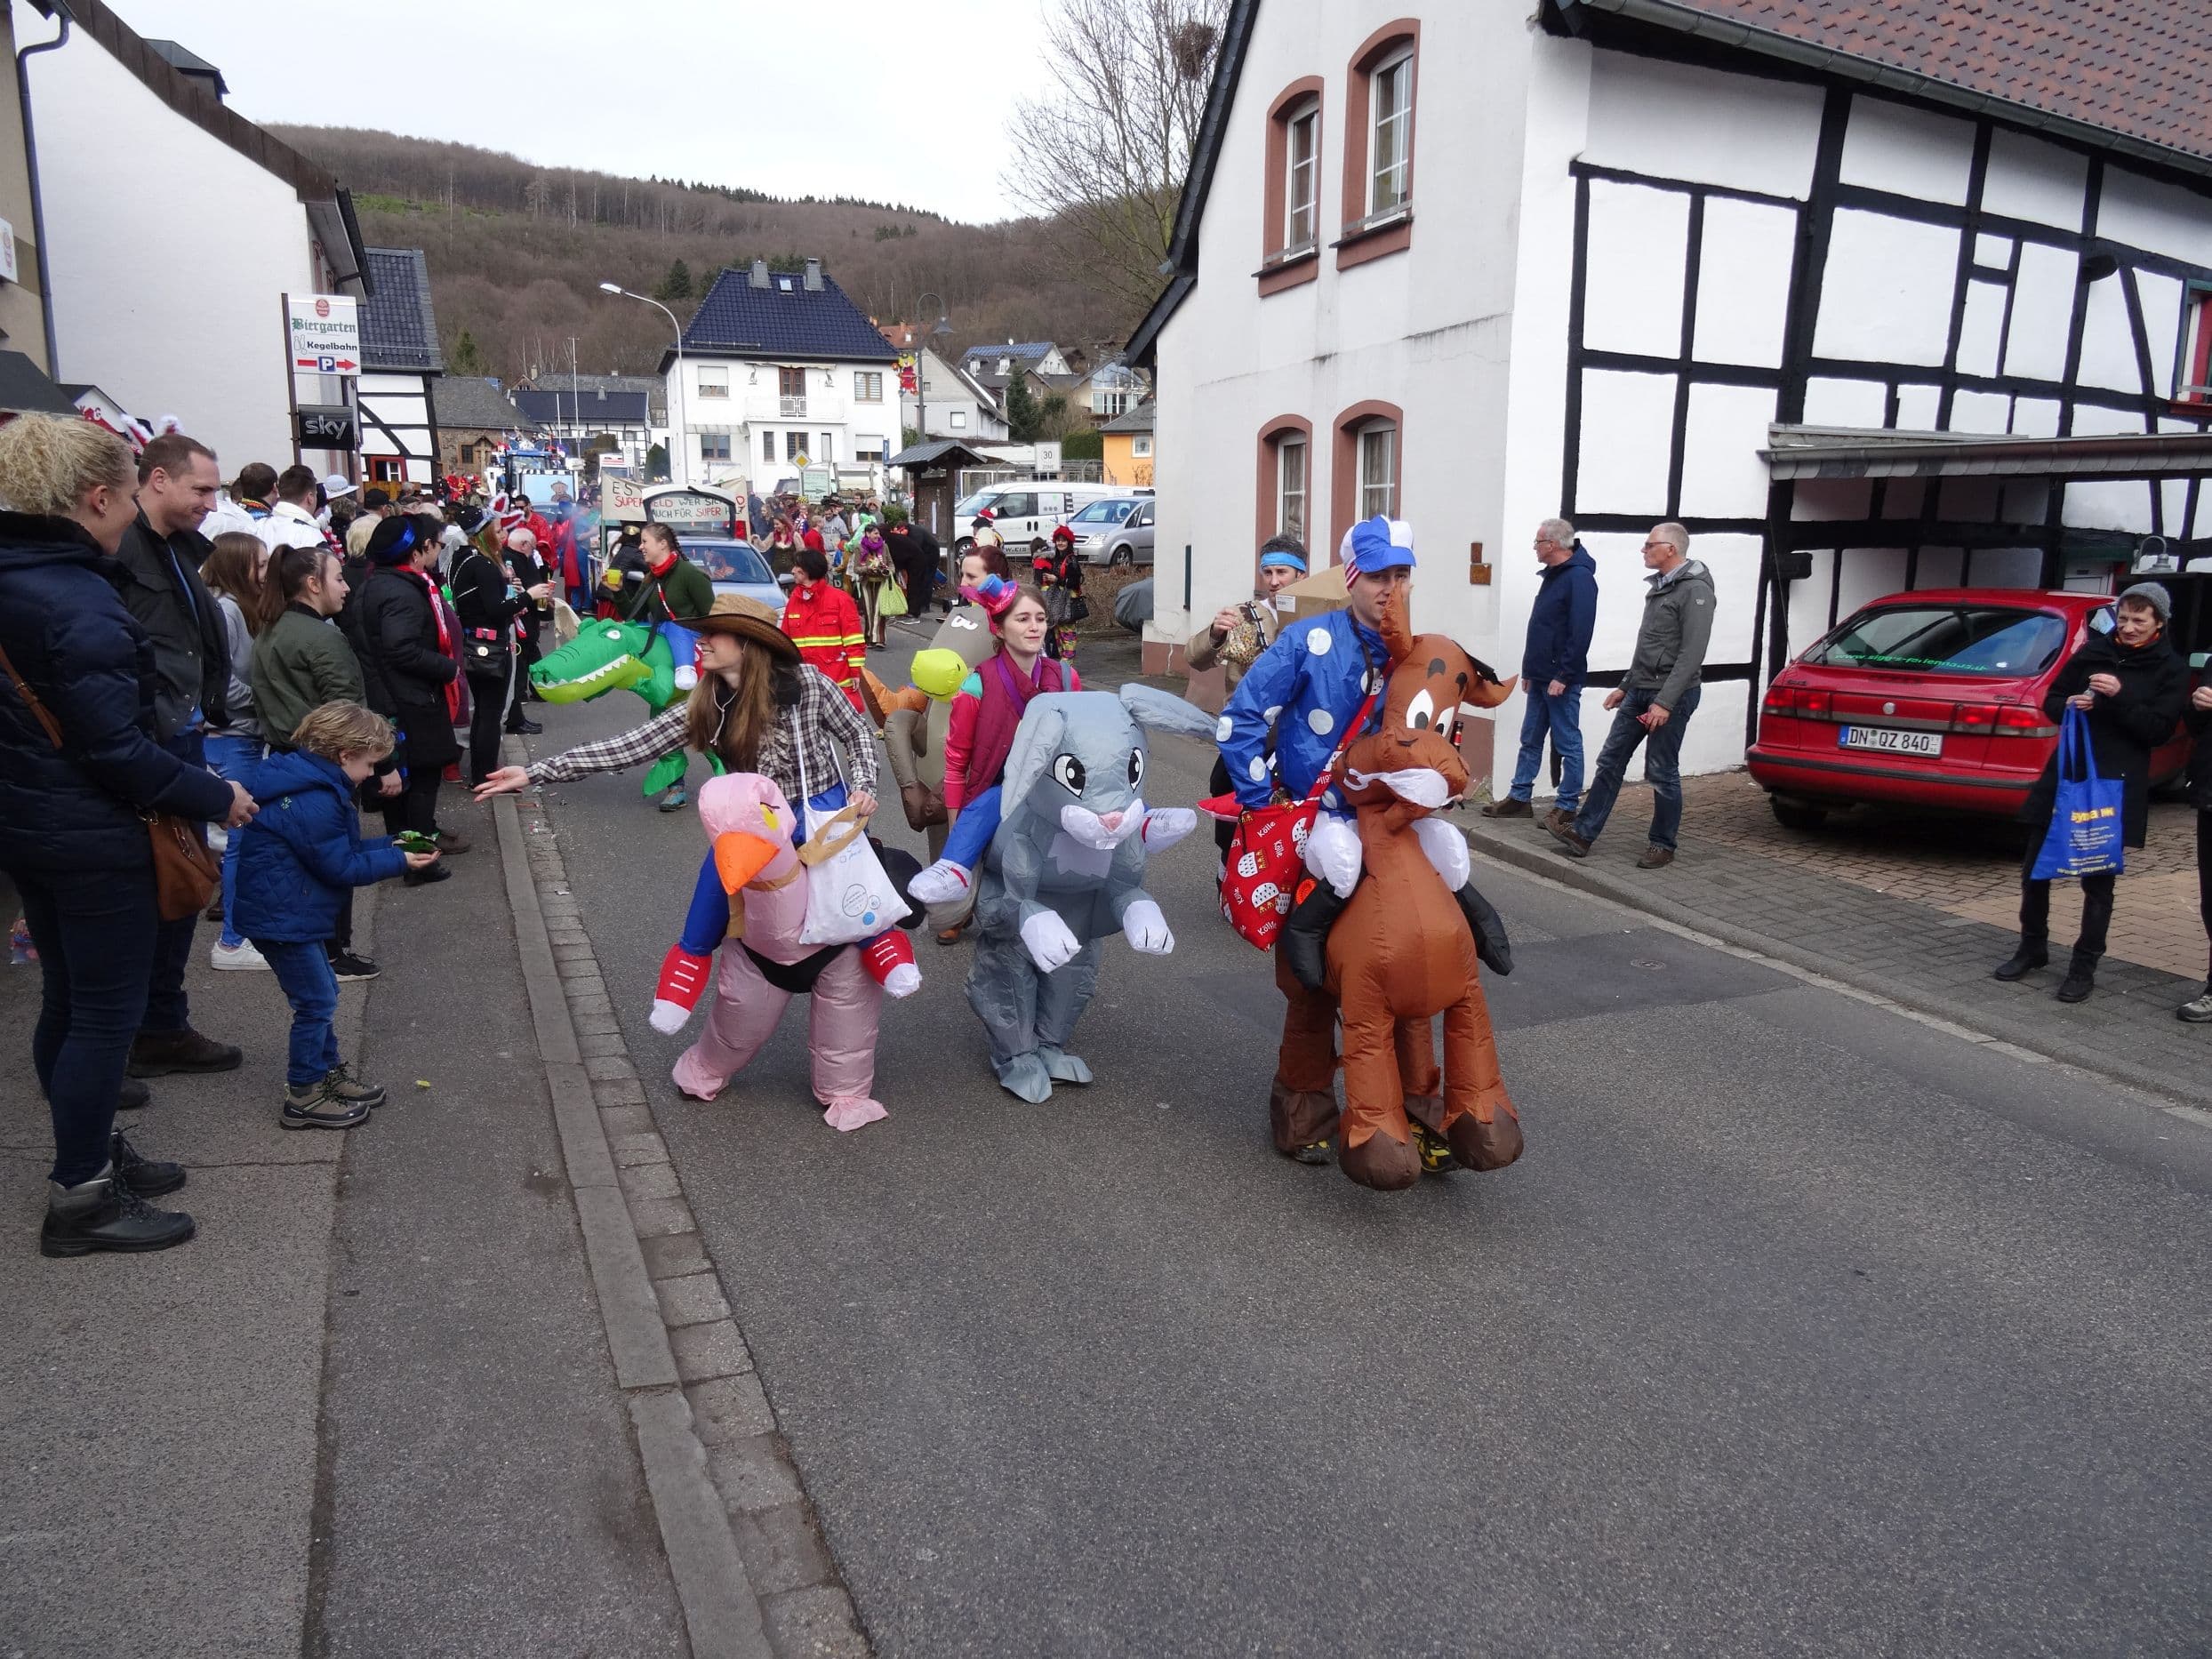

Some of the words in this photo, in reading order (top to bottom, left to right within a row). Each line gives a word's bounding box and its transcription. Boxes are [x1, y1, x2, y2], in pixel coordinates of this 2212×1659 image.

[292, 317, 357, 333] Biergarten
[307, 341, 357, 352] Kegelbahn
[322, 358, 333, 371] P
[305, 414, 348, 440] sky
[1043, 451, 1053, 460] 30
[613, 481, 633, 496] ES
[675, 508, 693, 517] FÜR
[695, 507, 721, 517] SUPER
[1849, 728, 1868, 744] DN
[1879, 732, 1898, 748] QZ
[1901, 734, 1930, 751] 840
[1316, 773, 1332, 784] ölle
[1257, 821, 1277, 838] Kölle
[1273, 839, 1284, 858] Kölle
